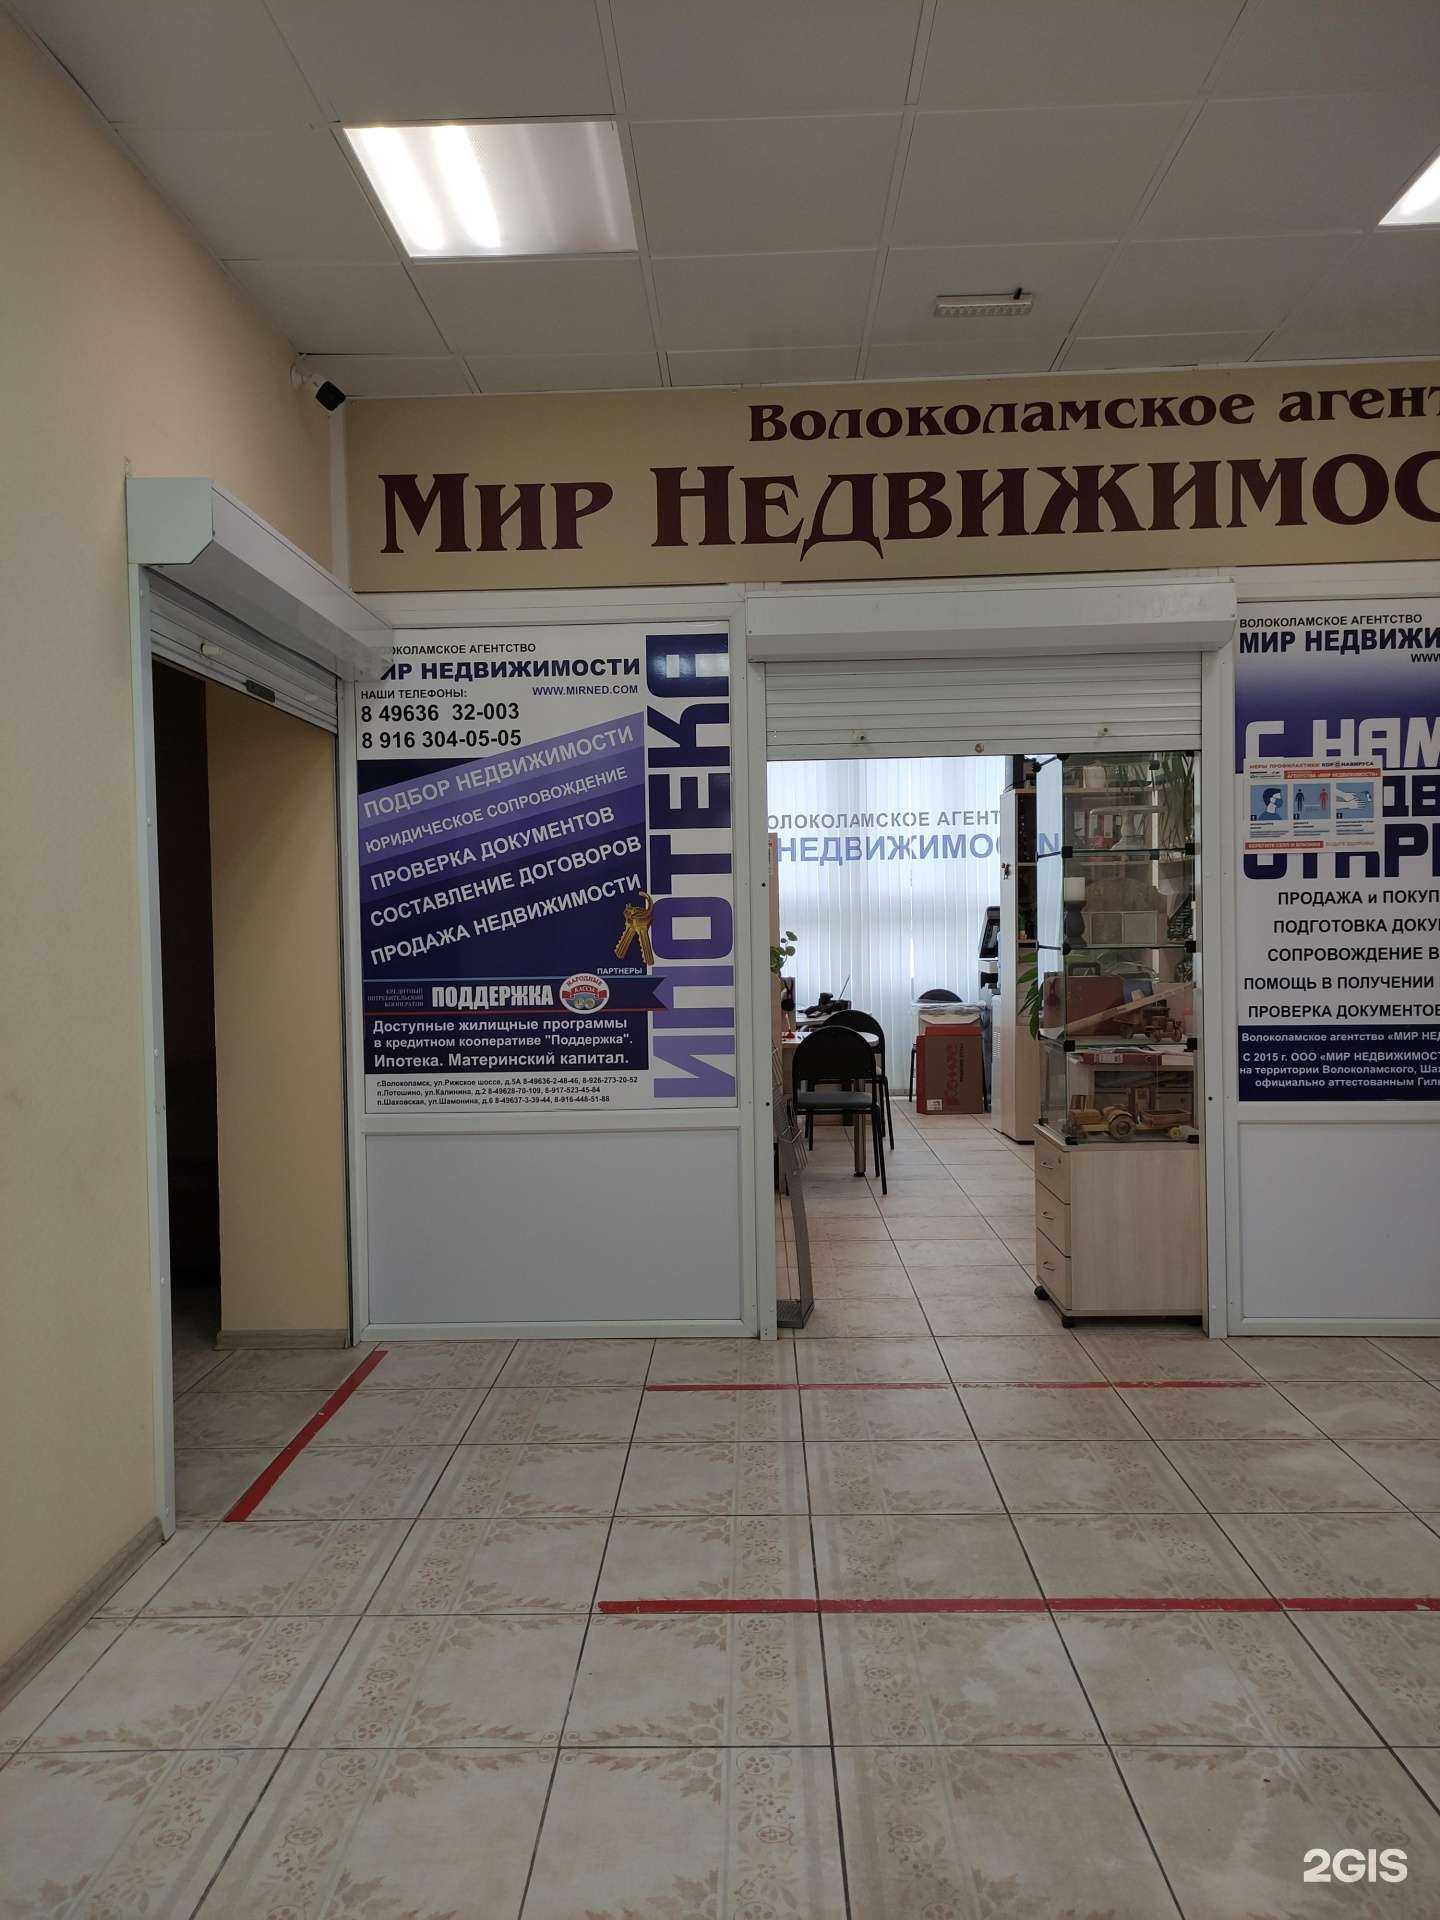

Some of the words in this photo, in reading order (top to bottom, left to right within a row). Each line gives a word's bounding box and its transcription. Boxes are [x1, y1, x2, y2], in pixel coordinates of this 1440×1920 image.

[748, 391, 1255, 442] Волоколамское
[1239, 616, 1347, 628] ВОЛОКОЛАМСКОЕ
[1351, 614, 1423, 625] АГЕНТСТВО
[392, 644, 466, 655] КОЛАМСКОЕ
[469, 643, 536, 653] АГЕНТСТВО
[1239, 631, 1296, 654] МИР
[1305, 627, 1440, 656] НЕДВИЖИ
[421, 658, 640, 682] НЕДВИЖИМОСТИ
[361, 690, 395, 700] НАШИ
[398, 689, 467, 699] ТЕЛЕФОНЫ:
[532, 685, 638, 696] WWW.MIRNED.COM
[361, 706, 372, 722] 8
[379, 704, 439, 722] 49636
[452, 703, 519, 721] 32-003
[362, 732, 373, 749] 8
[379, 731, 415, 749] 916
[422, 729, 522, 748] 304-05-05
[363, 778, 451, 819] ПОДБОР
[455, 725, 634, 793] НЕДВИЖИМОСТИ
[365, 808, 485, 854] ЮРИДИЧЕСКОЕ
[487, 766, 628, 818] СОПРОВОЖДЕНИЕ
[370, 848, 477, 891] ПРОВЕРКА
[479, 806, 616, 863] ДОКУМЕНТОВ
[645, 633, 736, 1098] ИПОТЕКА
[370, 871, 516, 928] СОСТАВЛЕНИЕ
[518, 836, 642, 888] ДОГОВОРОВ
[1277, 891, 1362, 907] ПРОДАЖА
[1368, 894, 1377, 904] и
[1383, 889, 1440, 904] ПОКУП
[370, 924, 471, 966] ПРОДАЖА
[473, 873, 642, 937] НЕДВИЖИМОСТИ
[1273, 919, 1388, 935] ПОДГОТОВКА
[1267, 947, 1423, 963] СОПРОВОЖДЕНИЕ
[597, 967, 643, 976] ПАРТНЕРЫ
[1243, 977, 1317, 991] ПОМОЩЬ
[1321, 977, 1333, 989] В
[1337, 975, 1434, 989] ПОЛУЧЕНИИ
[431, 984, 554, 1010] ПОДДЕРЖКА
[1248, 1005, 1332, 1018] ПРОВЕРКА
[373, 1020, 455, 1034] Доступные
[459, 1019, 539, 1033] жилищные
[543, 1018, 628, 1033] программы
[374, 1039, 382, 1048] в
[386, 1038, 455, 1050] кредитном
[459, 1036, 542, 1049] кооперативе
[545, 1034, 633, 1047] "Поддержка".
[1241, 1032, 1327, 1042] Волоколамское
[1329, 1033, 1385, 1042] агентство
[1387, 1031, 1419, 1041] «МИР
[374, 1054, 444, 1068] Ипотека.
[448, 1051, 556, 1069] Материнский
[560, 1052, 629, 1066] капитал.
[1242, 1053, 1251, 1062] С
[1254, 1053, 1278, 1062] 2015
[1281, 1054, 1288, 1062] г.
[1291, 1052, 1317, 1062] ООО
[1320, 1052, 1351, 1062] «МИР
[1239, 1067, 1252, 1075] на
[1254, 1066, 1319, 1076] территории
[1322, 1065, 1417, 1075] Волоколамского,
[1255, 1078, 1326, 1089] официально
[1328, 1078, 1415, 1087] аттестованным
